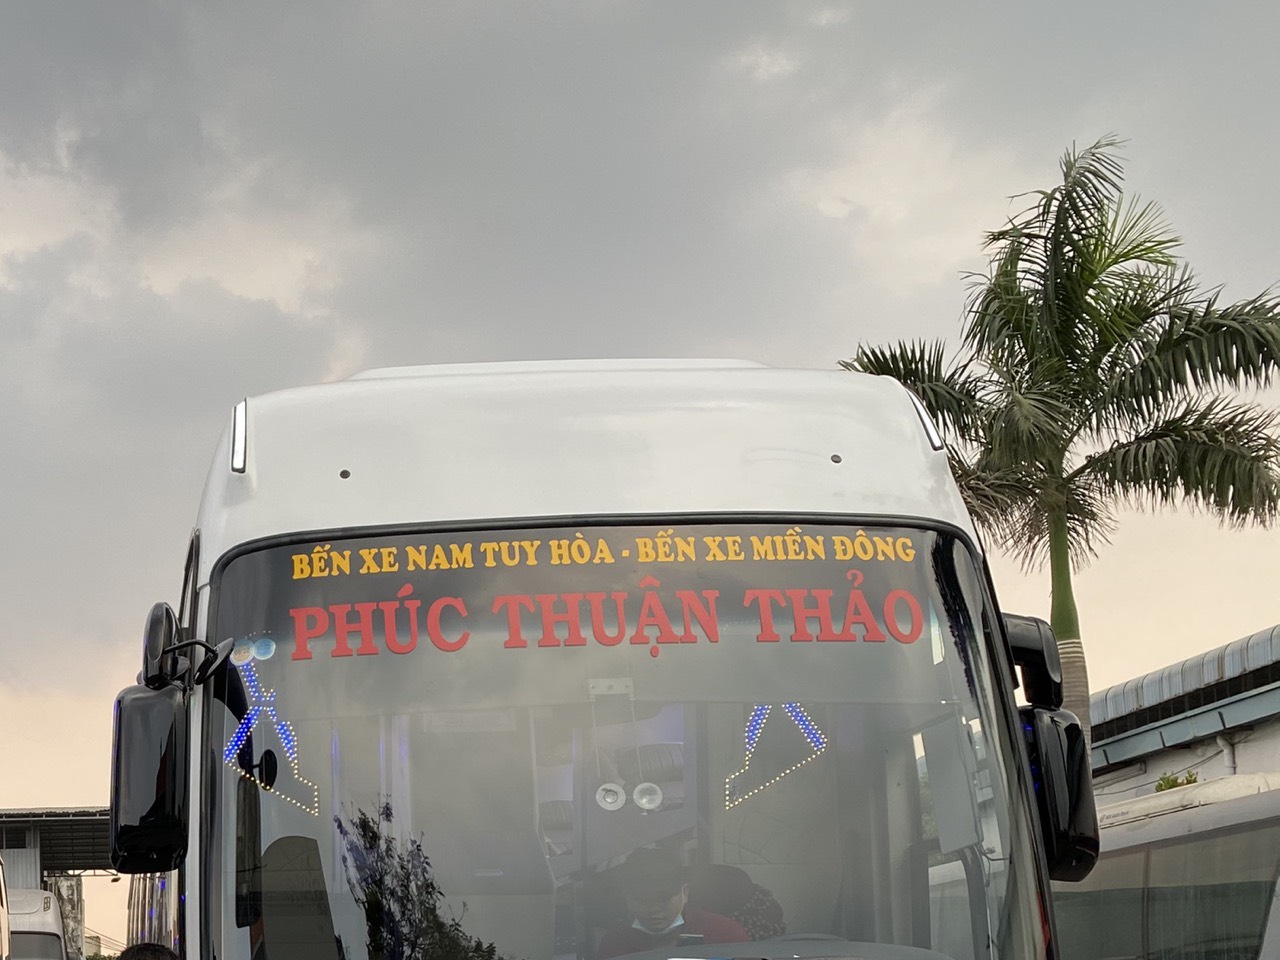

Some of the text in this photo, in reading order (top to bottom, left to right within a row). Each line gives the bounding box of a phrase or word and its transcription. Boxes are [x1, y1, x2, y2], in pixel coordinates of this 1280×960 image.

[291, 544, 351, 579] BẾN
[358, 547, 400, 574] XE
[405, 543, 475, 571] NAM
[480, 540, 541, 567] TUY
[549, 532, 615, 565] HÒA
[635, 529, 696, 562] BẾN
[703, 536, 745, 561] XE
[750, 527, 826, 561] MIỀN
[832, 529, 916, 562] ĐÔNG
[289, 569, 924, 661] PHÚC THUẬN THẢO
